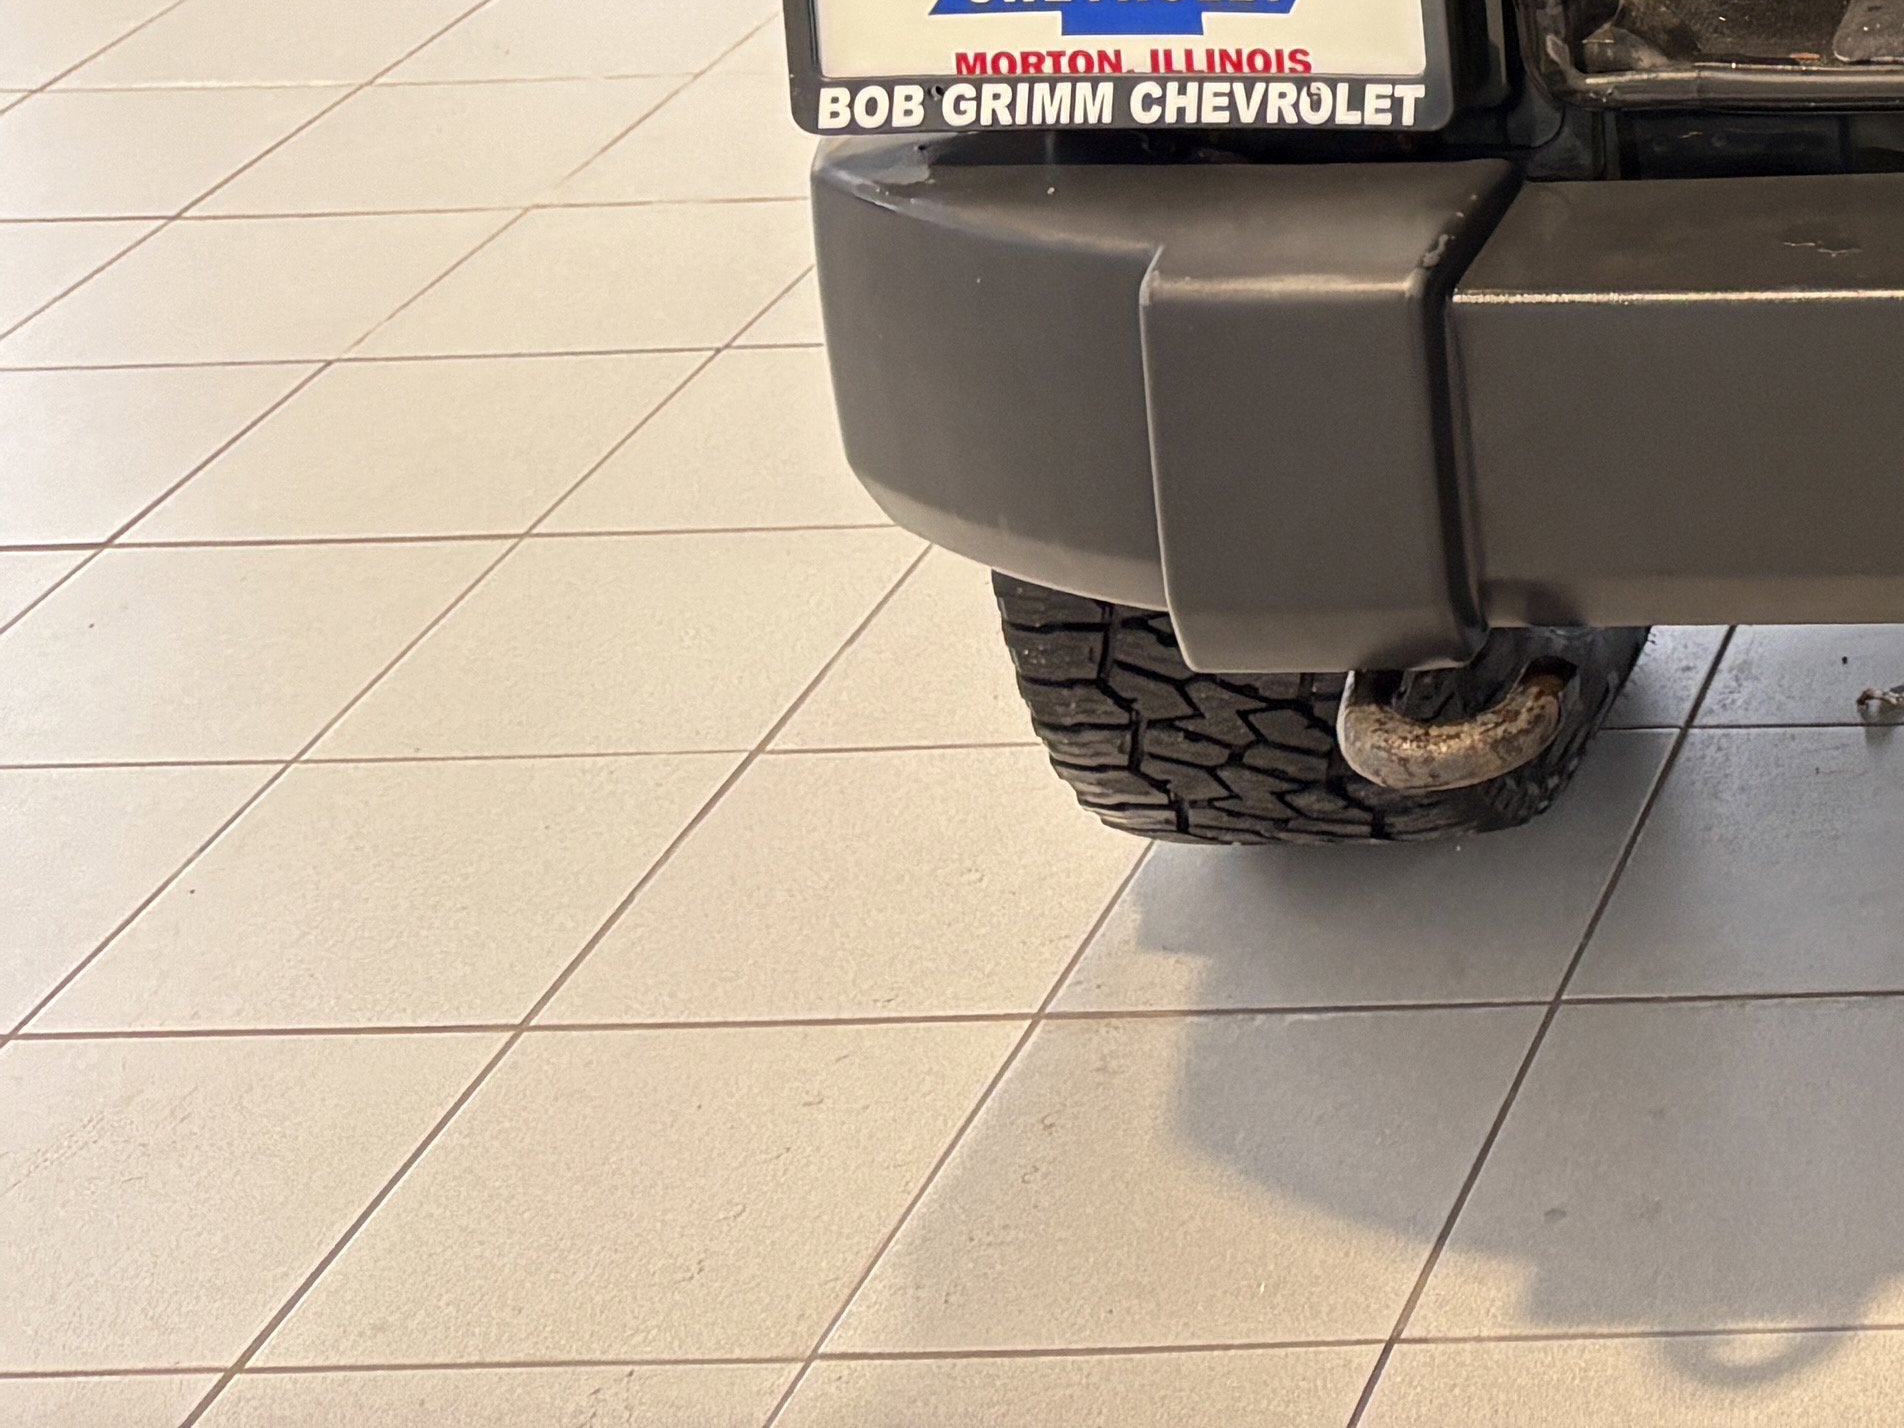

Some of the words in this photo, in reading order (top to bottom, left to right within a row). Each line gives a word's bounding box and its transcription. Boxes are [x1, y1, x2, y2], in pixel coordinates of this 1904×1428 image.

[955, 49, 1136, 75] MORTON
[1150, 48, 1312, 75] ILLINOIS
[817, 85, 925, 130] BOB
[941, 82, 1114, 128] GRIMM
[1129, 82, 1426, 128] CHEVROLET
